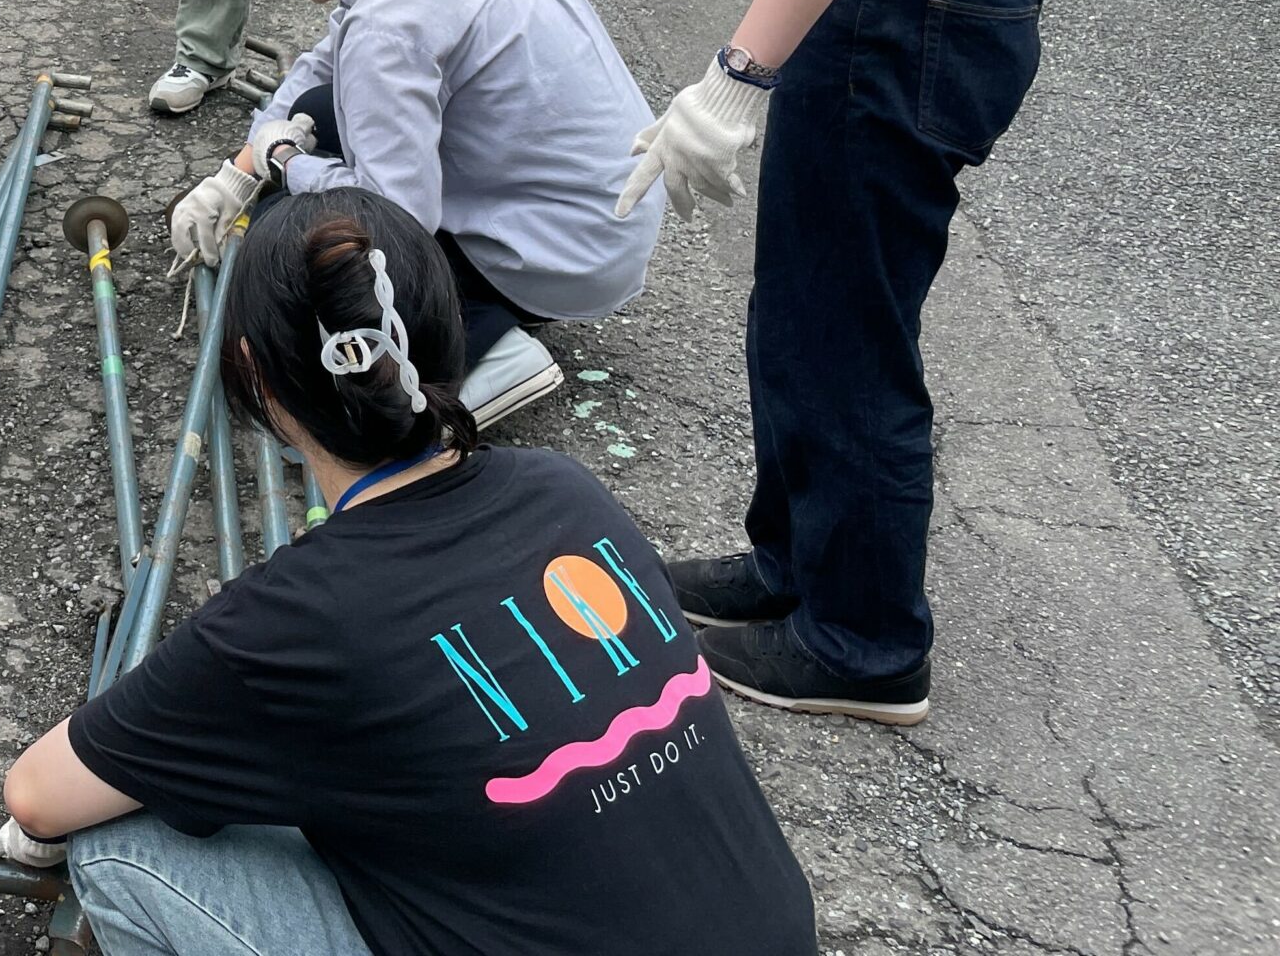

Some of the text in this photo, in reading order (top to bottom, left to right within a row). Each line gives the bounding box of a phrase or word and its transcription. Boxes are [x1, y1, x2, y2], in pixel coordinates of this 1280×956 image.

[430, 537, 677, 743] NIKE
[589, 722, 707, 815] JUST DO IT.
